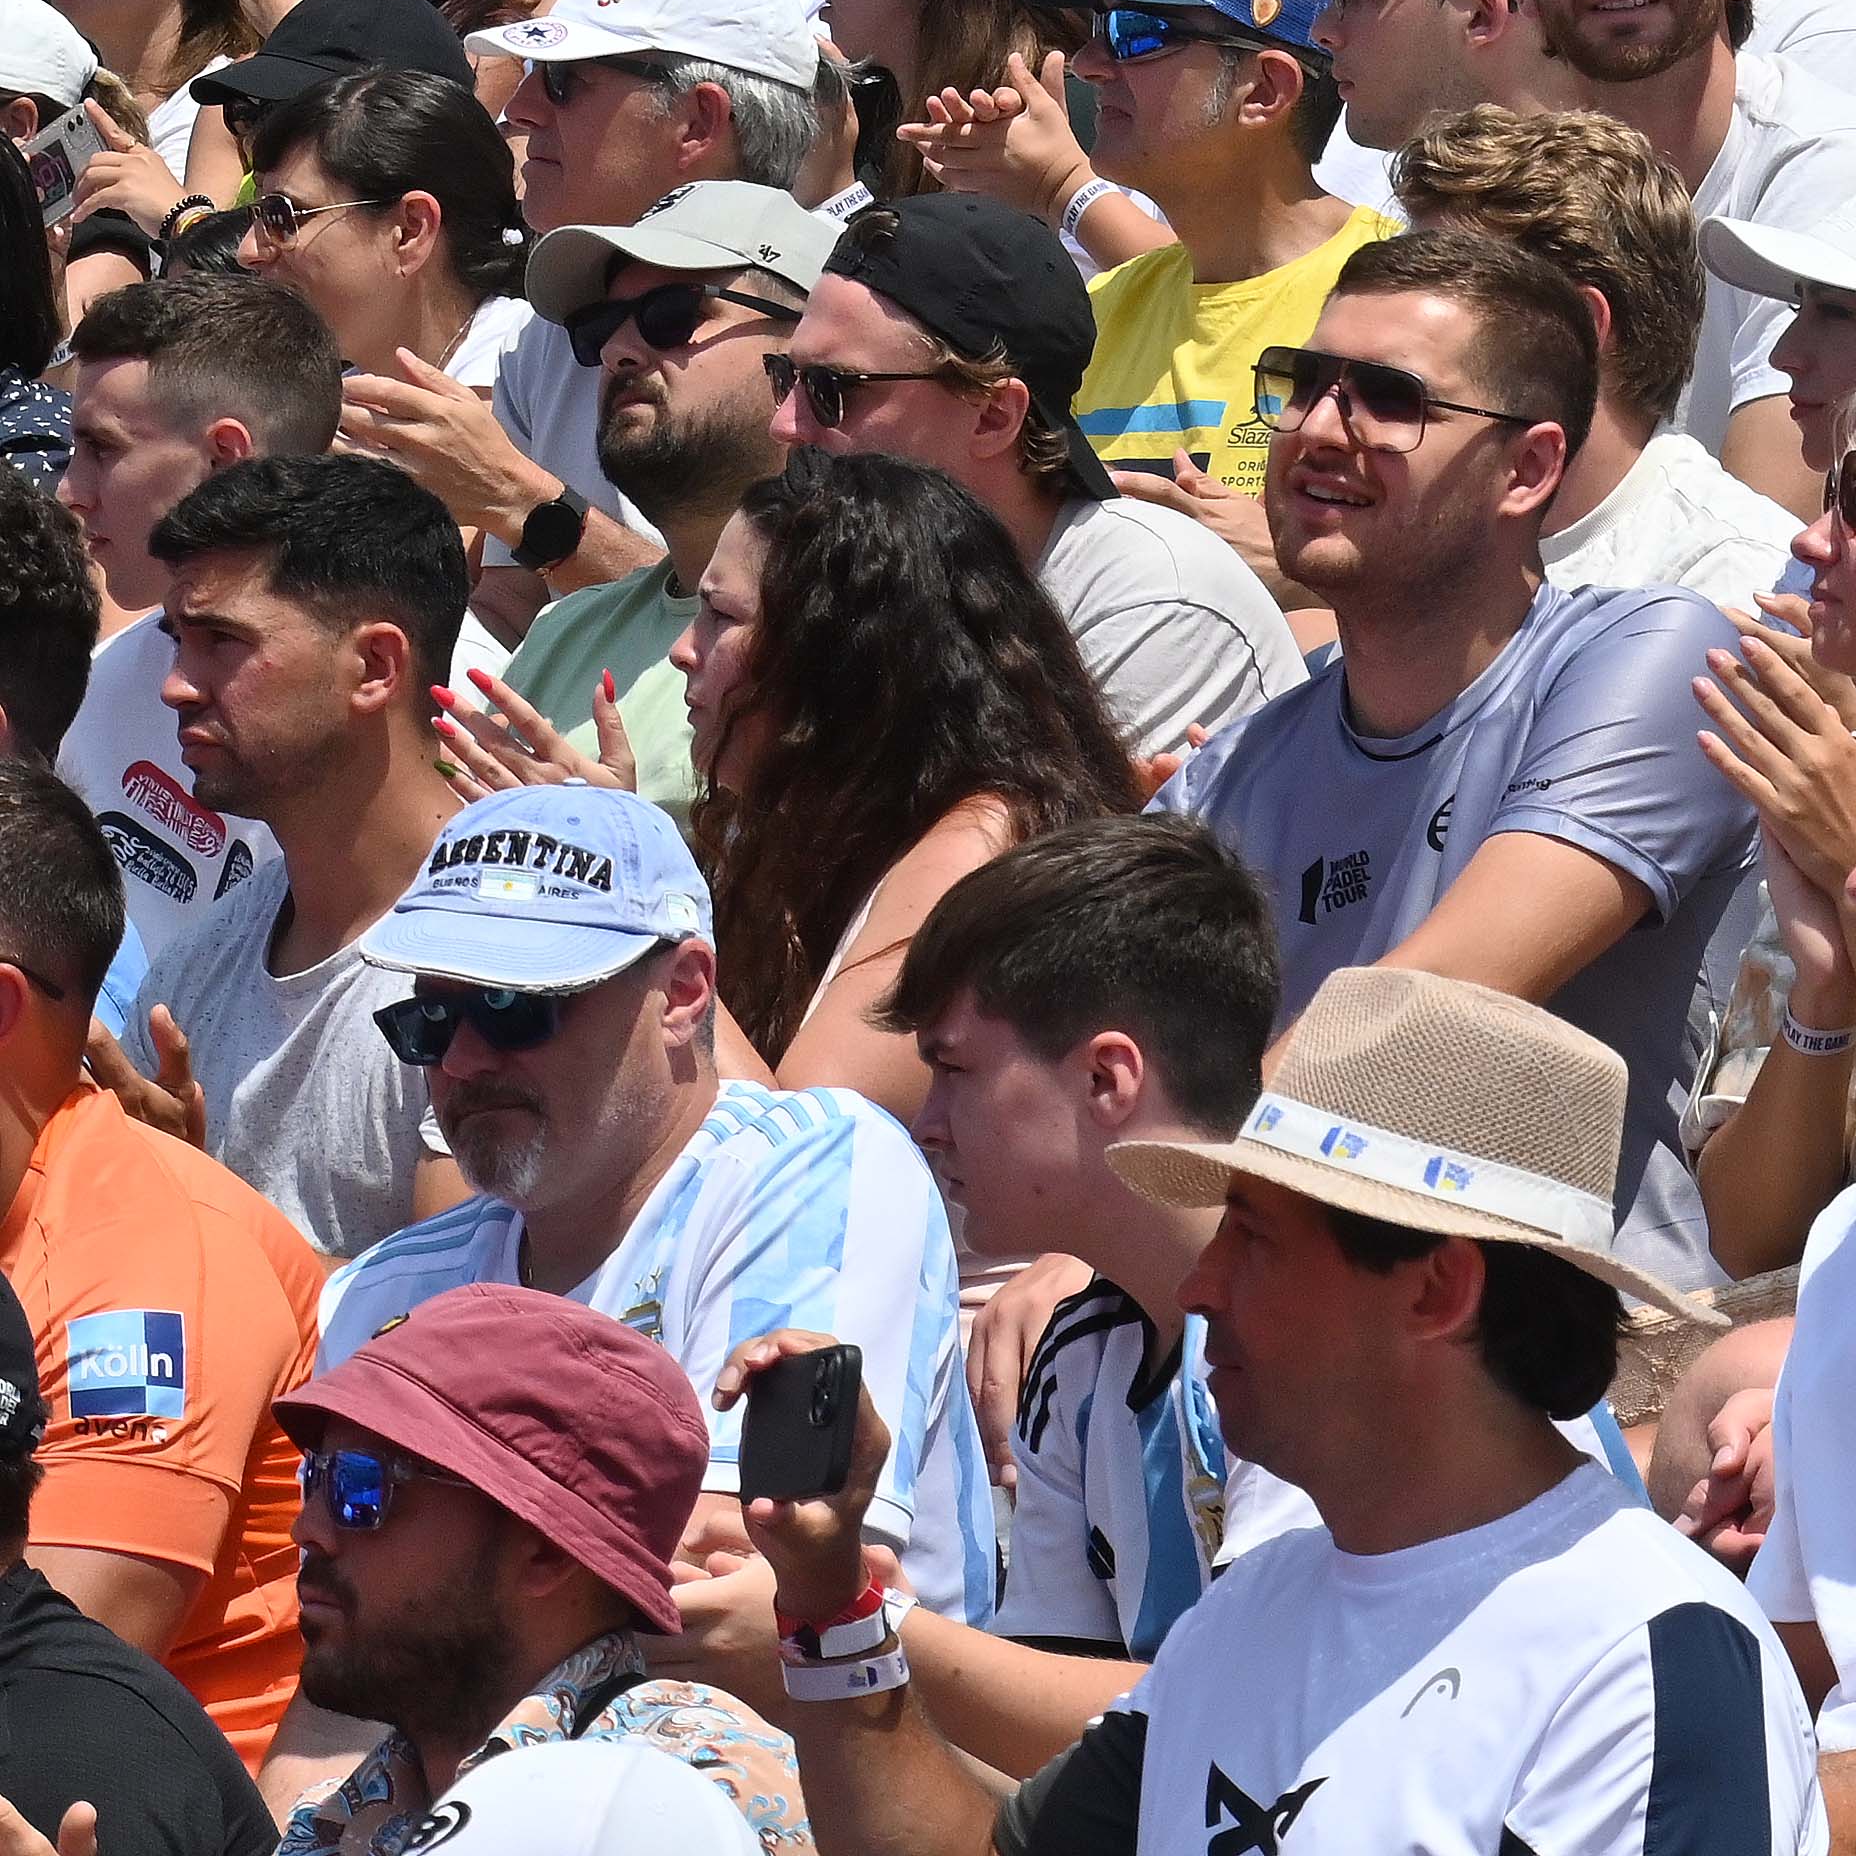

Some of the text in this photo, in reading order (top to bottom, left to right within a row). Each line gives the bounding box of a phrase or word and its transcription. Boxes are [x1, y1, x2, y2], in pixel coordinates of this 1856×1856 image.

[827, 202, 845, 217] PLAY
[843, 193, 859, 211] THE
[1076, 196, 1090, 214] THE
[429, 829, 614, 892] ARGENTINA
[432, 875, 582, 902] BUENOS AIRES
[1323, 868, 1373, 892] PADEL
[1321, 883, 1370, 913] TOUR
[1803, 1034, 1824, 1051] THE
[80, 1343, 174, 1380] Kölln
